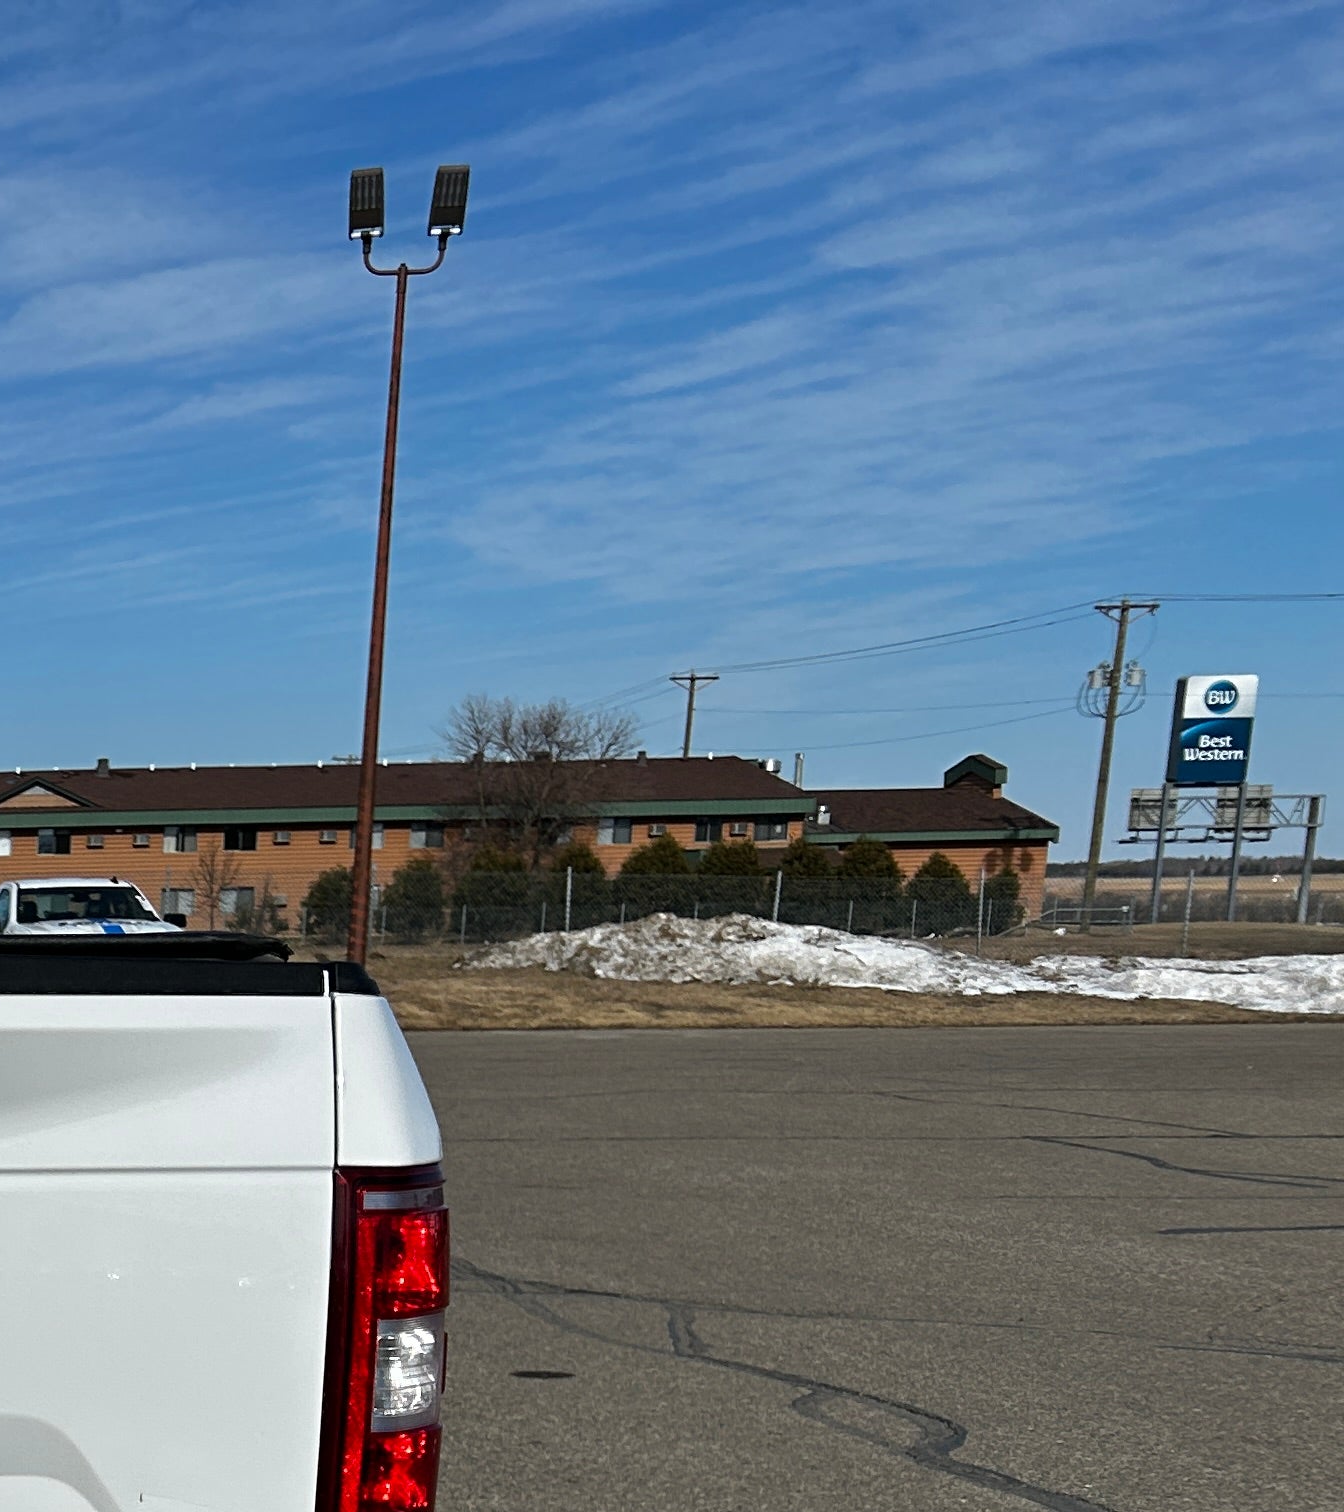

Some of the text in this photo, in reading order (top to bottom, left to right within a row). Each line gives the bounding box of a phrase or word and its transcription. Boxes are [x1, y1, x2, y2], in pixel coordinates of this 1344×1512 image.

[1207, 690, 1236, 705] BW
[1199, 734, 1233, 748] Best
[1183, 748, 1244, 761] Western
